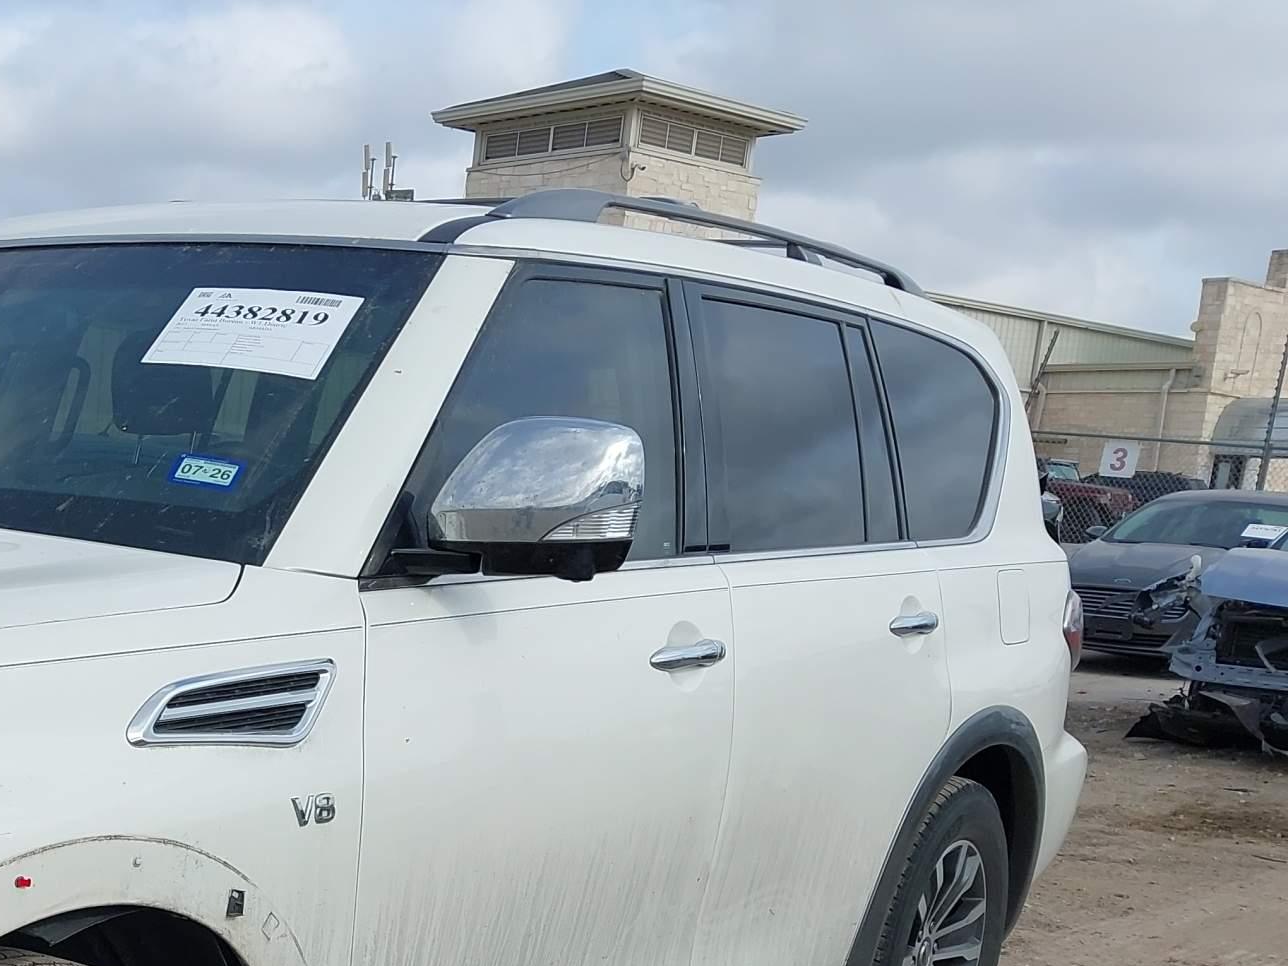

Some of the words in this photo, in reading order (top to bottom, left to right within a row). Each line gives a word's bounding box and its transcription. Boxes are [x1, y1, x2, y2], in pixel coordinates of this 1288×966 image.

[194, 303, 330, 327] 44382819
[1109, 447, 1128, 471] 3
[290, 793, 336, 827] V8
